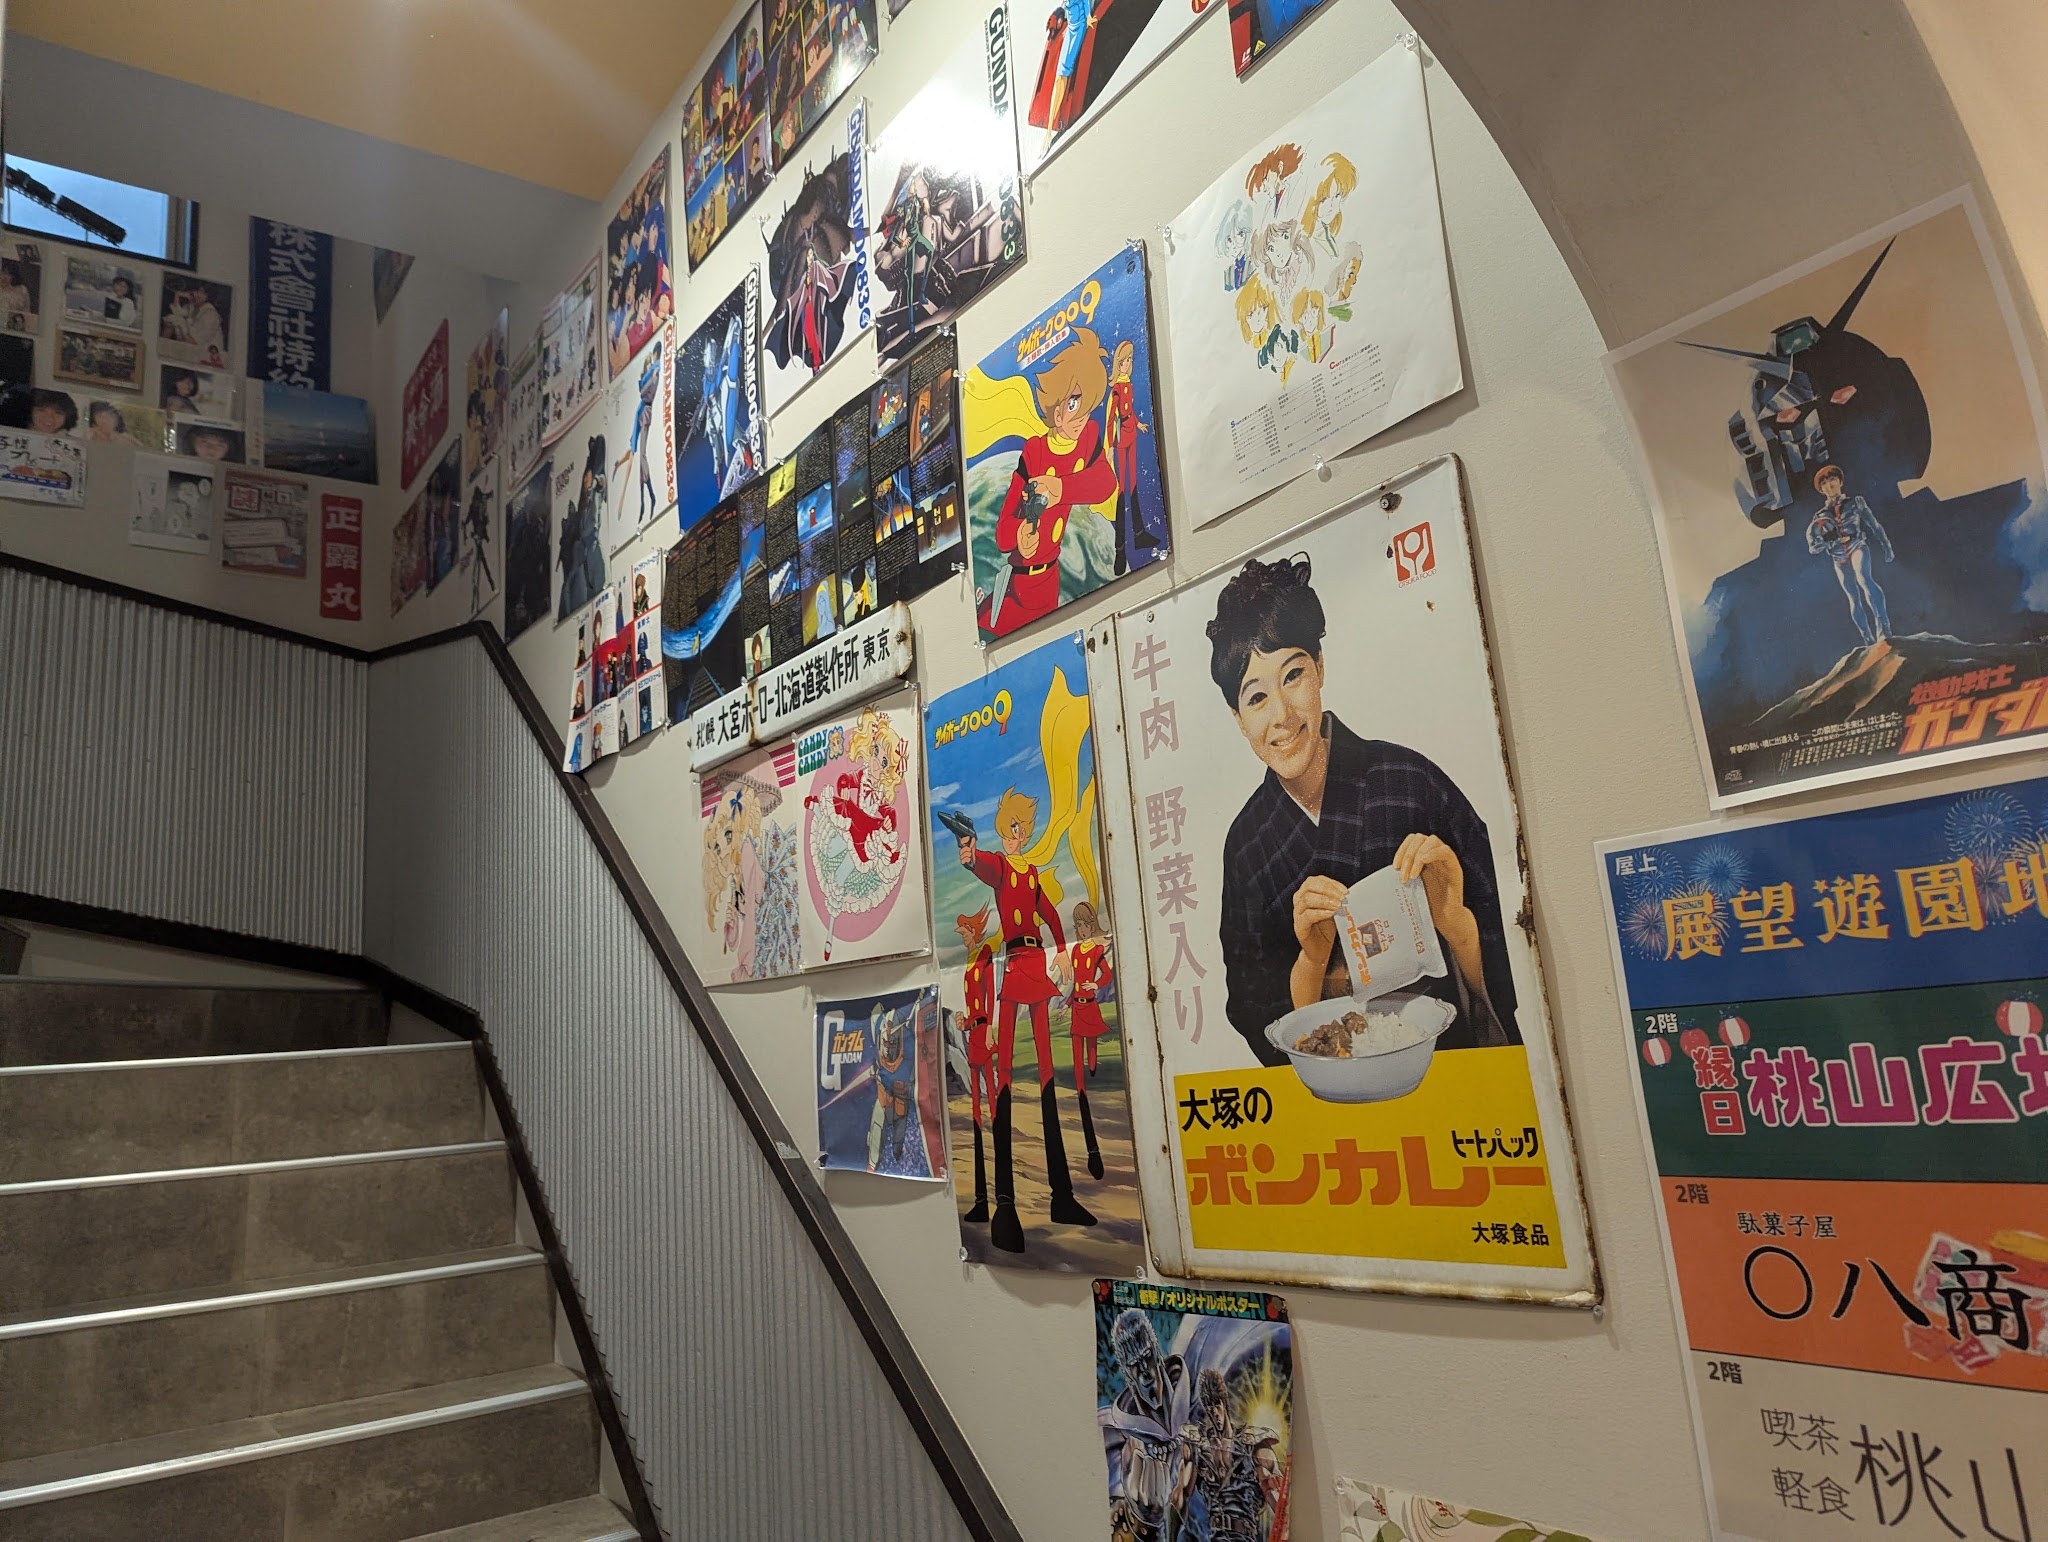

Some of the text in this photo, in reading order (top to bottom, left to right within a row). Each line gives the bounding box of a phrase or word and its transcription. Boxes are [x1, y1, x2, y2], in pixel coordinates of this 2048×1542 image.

[324, 505, 361, 613] 正露丸
[1420, 568, 1437, 579] FOOD
[695, 627, 891, 750] 札幌 大宮ホーロー北海道製作所 東京
[934, 688, 1013, 750] サイボーグ009
[798, 728, 828, 758] CANDY
[798, 748, 829, 776] CANDY
[1131, 634, 1208, 1046] 牛肉 野菜入り
[1615, 853, 1658, 877] 屋上
[1645, 1012, 1679, 1034] 2階
[832, 1029, 865, 1054] ガンダム
[1691, 1045, 1747, 1136] 縁日
[1179, 1086, 1273, 1131] 大塚の
[1451, 1126, 1540, 1160] ヒートパック
[1185, 1134, 1547, 1208] ボンカレー
[1674, 1184, 1710, 1204] 2階
[1471, 1221, 1550, 1247] 大塚食品
[1737, 1212, 1838, 1239] 駄菓子屋
[1707, 1361, 1743, 1384] 2階
[1760, 1407, 1839, 1455] 喫茶
[1771, 1467, 1856, 1521] 軽食
